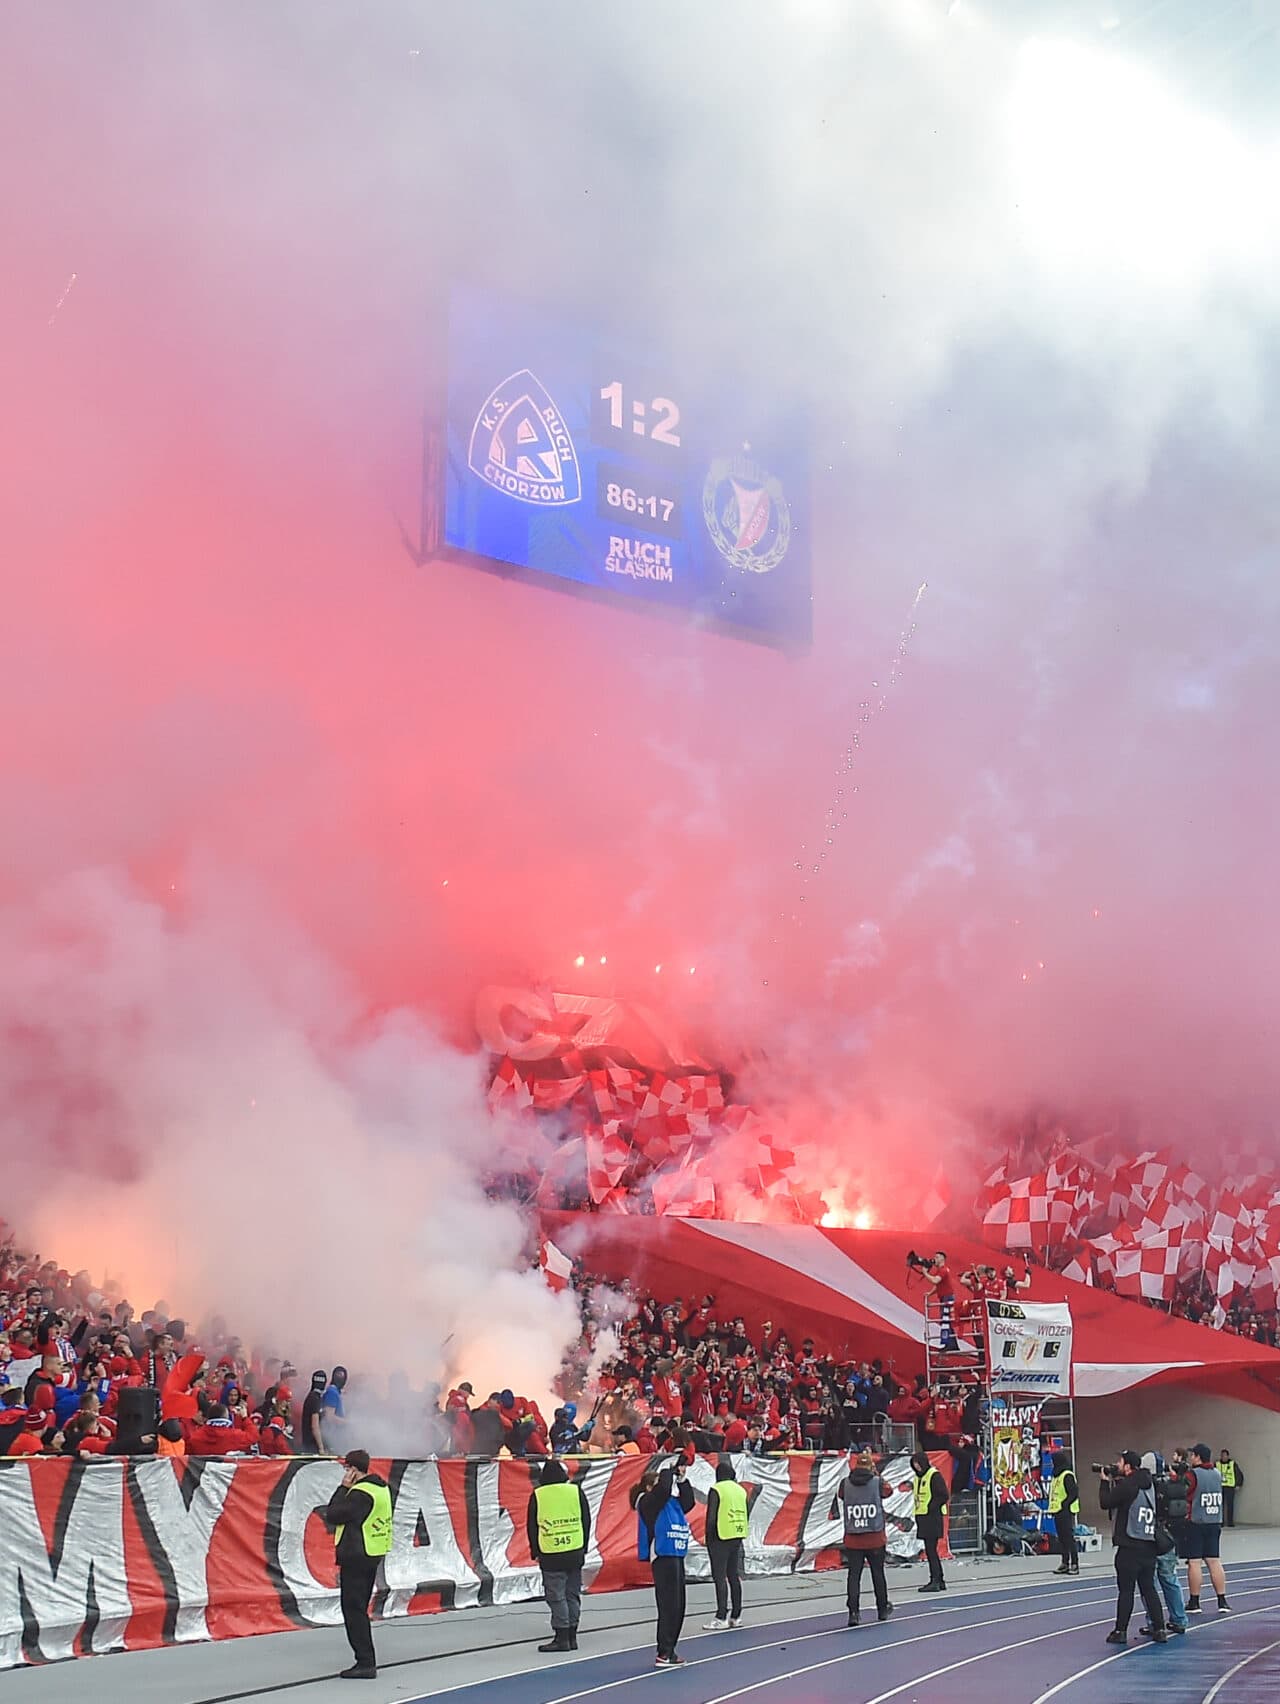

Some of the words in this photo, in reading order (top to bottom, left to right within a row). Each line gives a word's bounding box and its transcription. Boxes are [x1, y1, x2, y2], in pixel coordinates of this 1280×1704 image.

[600, 381, 680, 447] 1:2
[543, 407, 572, 461] RUCH
[606, 483, 674, 522] 86:17
[609, 536, 671, 566] RUCH
[992, 1404, 1042, 1427] CHAMY
[847, 1504, 877, 1520] FOTO
[1201, 1493, 1222, 1507] FOTO
[1138, 1507, 1154, 1524] FO
[554, 1536, 571, 1546] 345
[0, 1460, 238, 1668] MY
